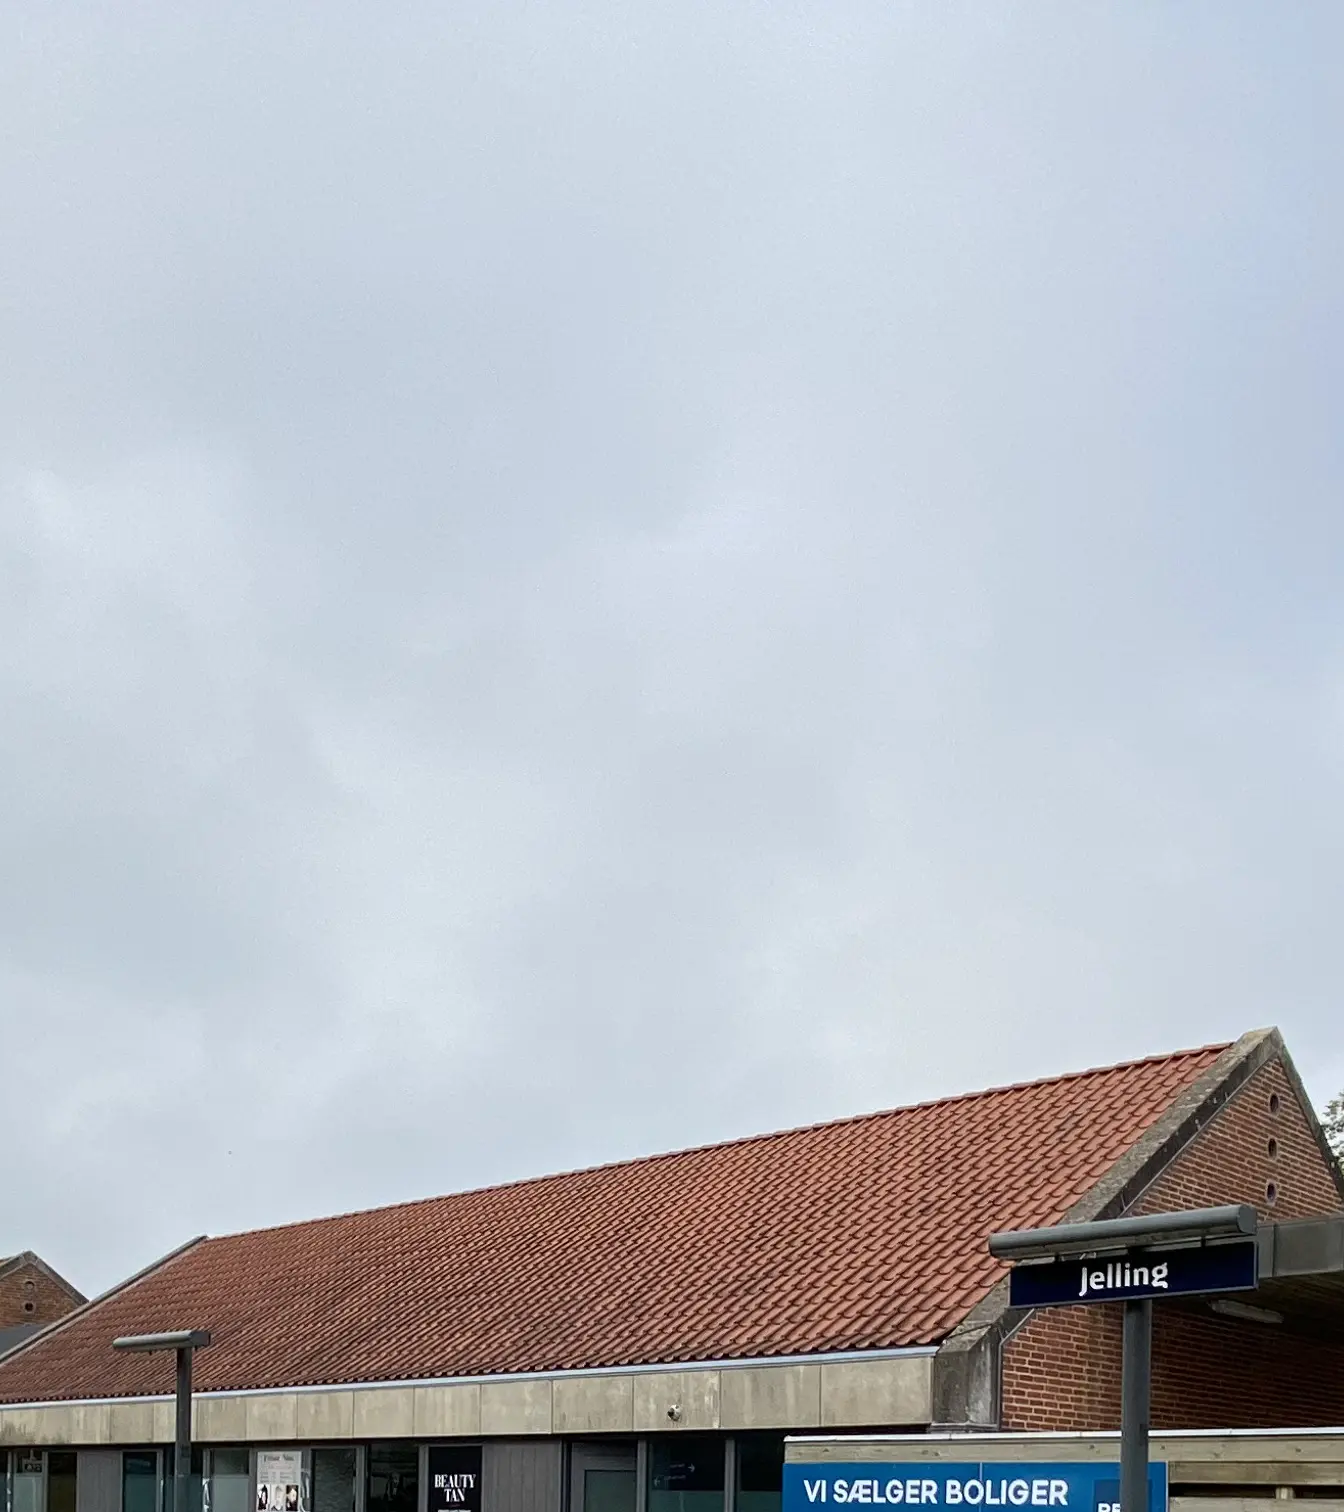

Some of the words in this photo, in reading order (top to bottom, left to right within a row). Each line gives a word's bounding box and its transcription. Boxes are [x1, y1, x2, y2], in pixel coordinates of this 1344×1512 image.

[1079, 1262, 1168, 1297] Jelling
[434, 1474, 476, 1488] BEAUTY
[444, 1488, 465, 1502] TAN
[803, 1480, 826, 1502] VI
[833, 1479, 938, 1504] SÆLGER
[946, 1479, 1068, 1506] BOLIGER
